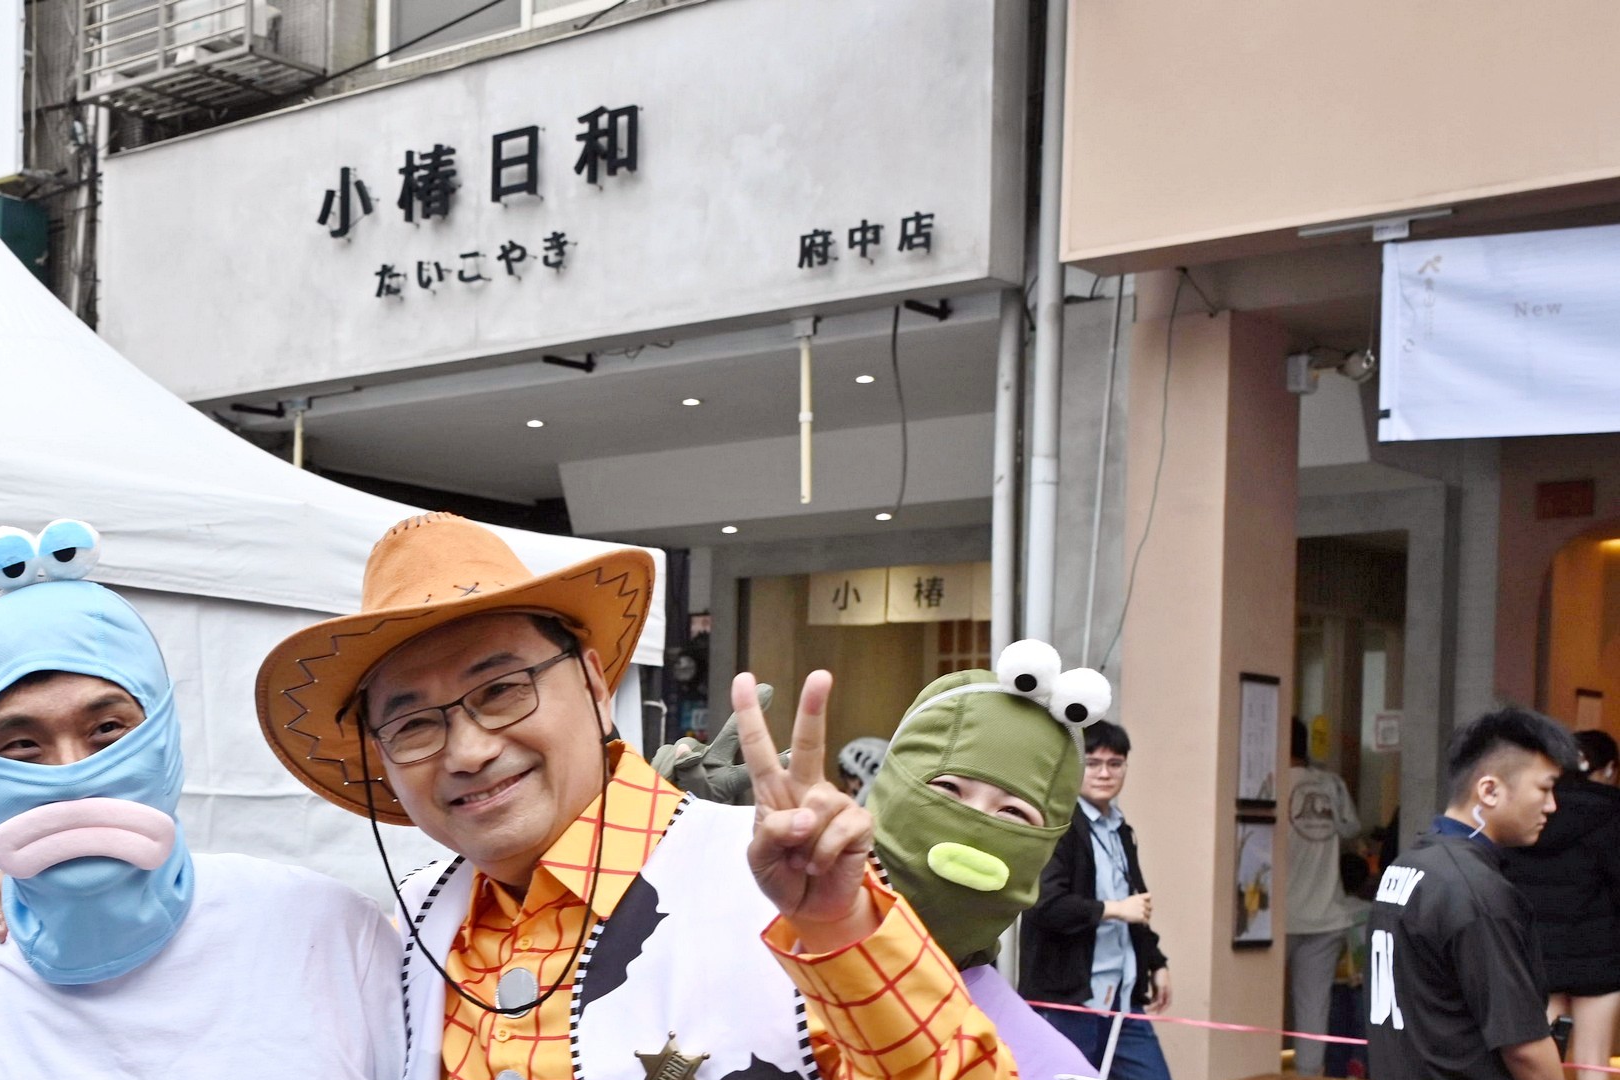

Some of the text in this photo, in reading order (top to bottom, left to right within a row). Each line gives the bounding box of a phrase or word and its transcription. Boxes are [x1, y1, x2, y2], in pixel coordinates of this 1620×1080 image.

[317, 104, 640, 238] 小椿日和
[374, 231, 569, 298] たいこやき
[797, 211, 935, 269] 府中店
[1513, 302, 1563, 319] New
[832, 575, 945, 611] 小椿
